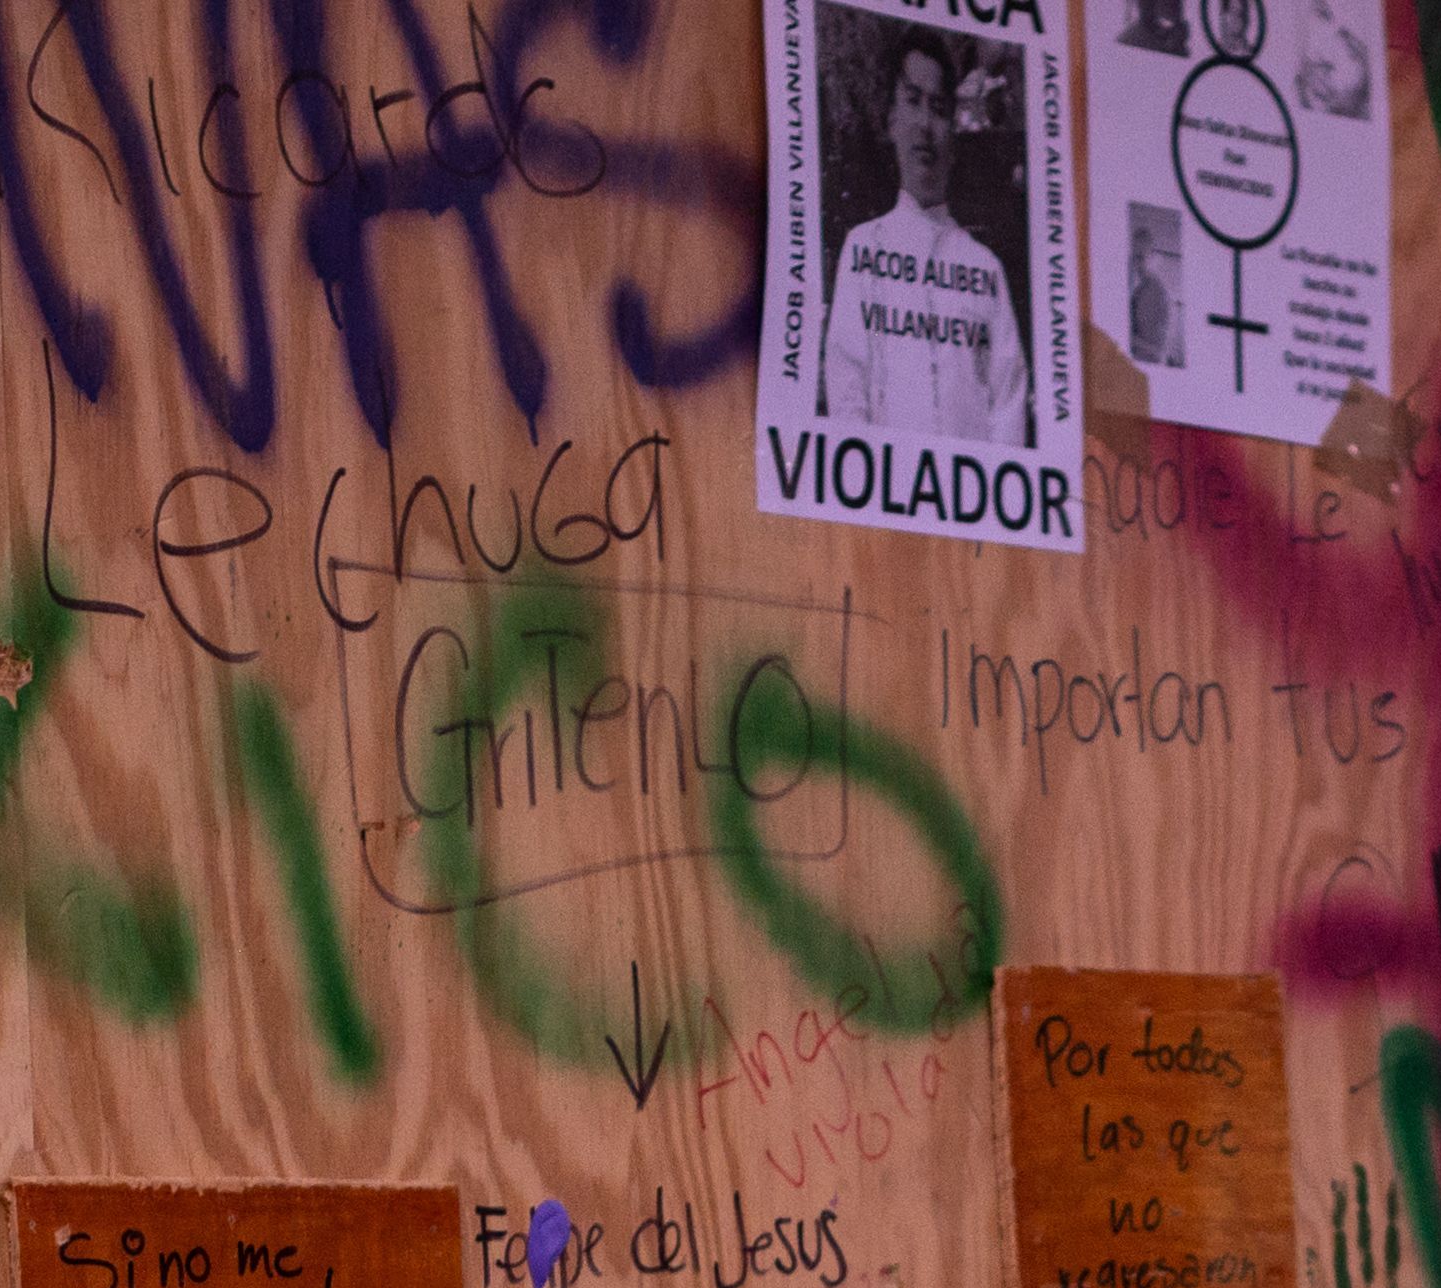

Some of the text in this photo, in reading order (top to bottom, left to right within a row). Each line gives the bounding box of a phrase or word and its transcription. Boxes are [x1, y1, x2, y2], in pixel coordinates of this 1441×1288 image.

[786, 178, 808, 284] ALIBEN
[1042, 50, 1072, 424] JACOB ALIBEN VILLANUEVA
[850, 244, 999, 299] JACOB ALIBEN
[781, 288, 806, 384] JACOB
[860, 302, 993, 350] VILLANUEVA
[766, 427, 1074, 539] VIOLADOR
[1035, 1013, 1248, 1088] Por todas
[1080, 1103, 1242, 1172] las que
[629, 1185, 704, 1280] del
[1108, 1193, 1164, 1237] no
[158, 1243, 214, 1288] no
[235, 1238, 306, 1280] me
